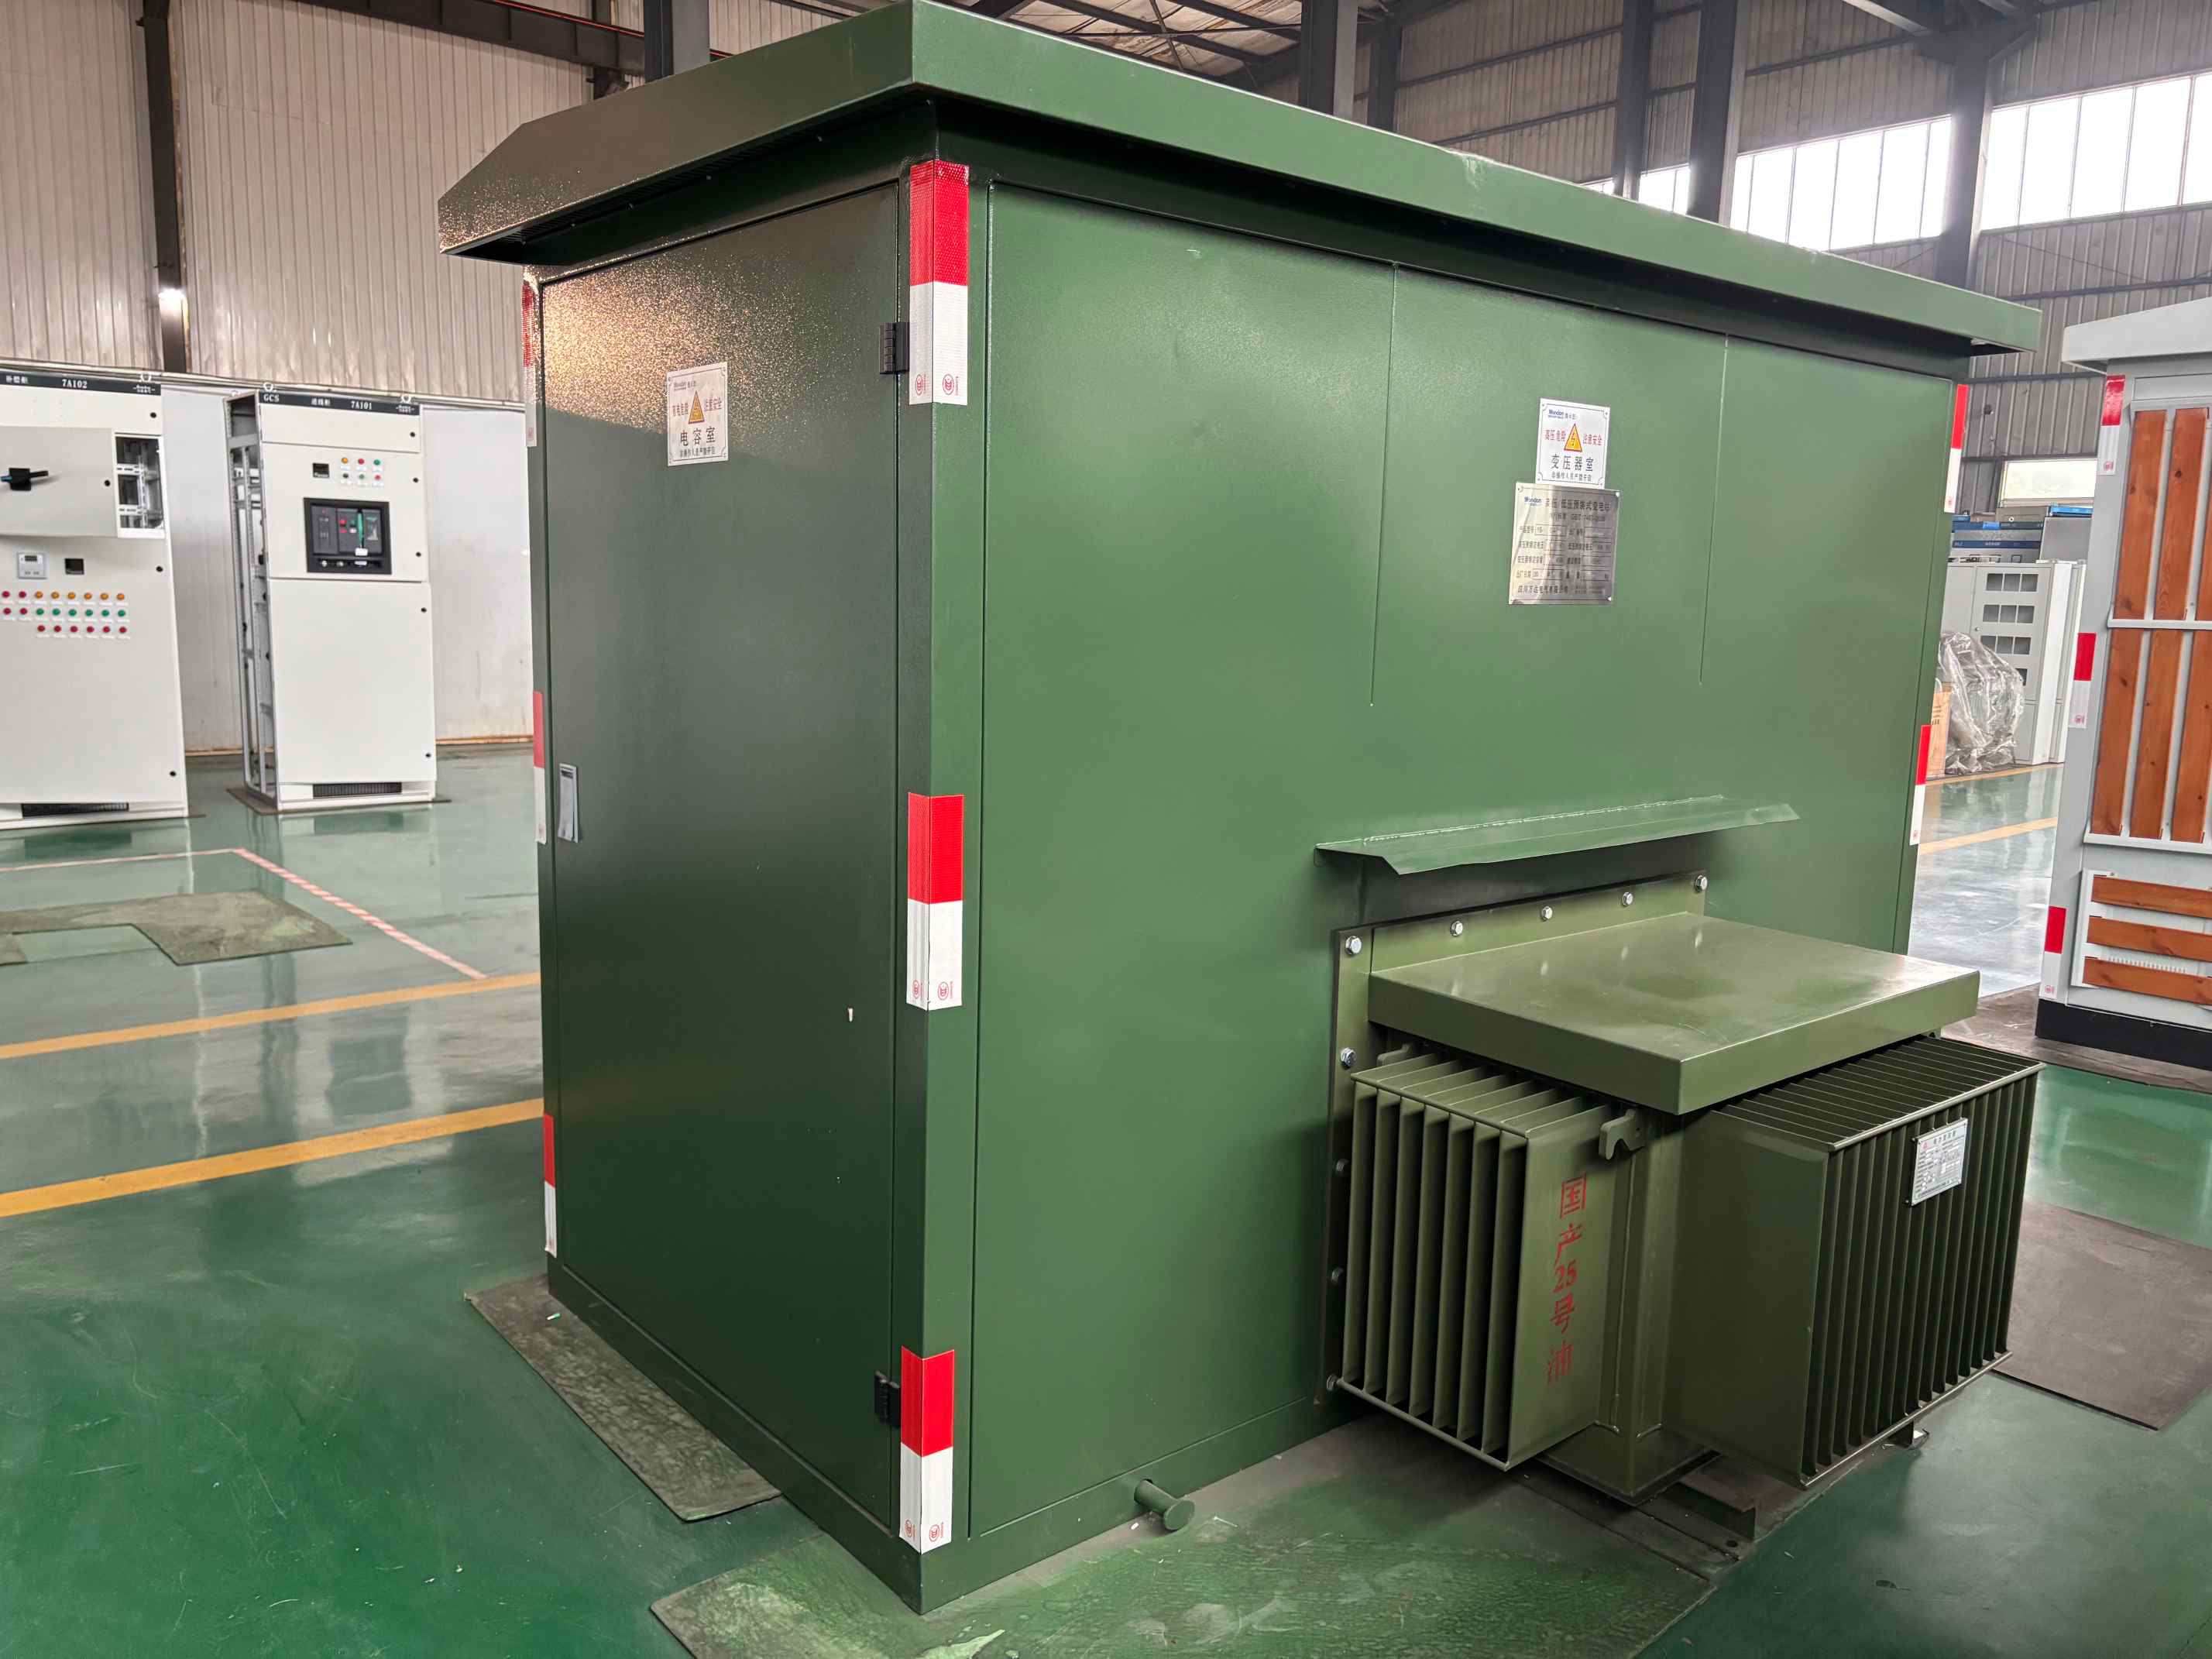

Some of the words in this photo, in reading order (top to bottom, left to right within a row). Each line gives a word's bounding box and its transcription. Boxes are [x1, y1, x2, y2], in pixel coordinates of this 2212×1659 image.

[263, 394, 280, 403] GCS
[351, 400, 373, 410] 7A101
[680, 426, 715, 446] 电容室
[1545, 429, 1566, 442] 高压危险
[1583, 433, 1602, 445] 注意安全
[1551, 454, 1594, 472] 变压器室
[1547, 1171, 1588, 1387] 国产25号油
